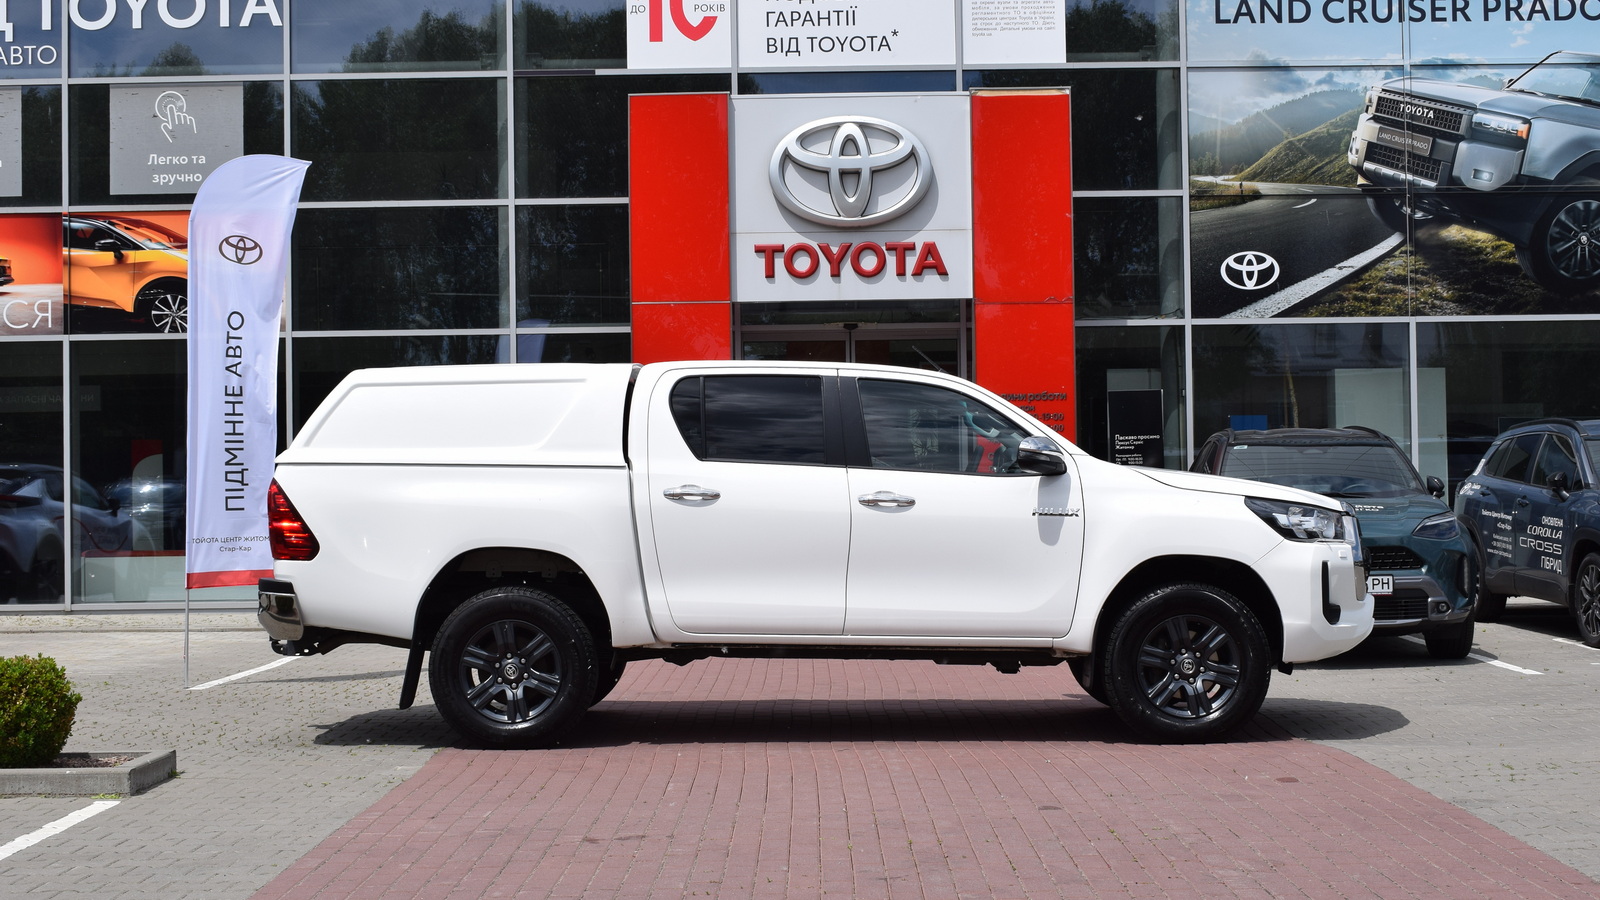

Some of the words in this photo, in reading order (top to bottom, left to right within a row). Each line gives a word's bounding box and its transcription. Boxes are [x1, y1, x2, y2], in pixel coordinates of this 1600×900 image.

[630, 5, 646, 15] ДО
[694, 4, 726, 13] РОКІВ
[1214, 0, 1313, 25] LAND
[1321, 0, 1472, 24] CRUISER
[1482, 0, 1600, 23] PRADO
[766, 6, 859, 28] ГАРАНТІЇ
[766, 37, 801, 56] ВІД
[1400, 103, 1434, 119] TOYOTA
[1378, 132, 1392, 140] LAND
[147, 154, 189, 165] Легко
[191, 155, 206, 165] та
[152, 173, 203, 184] зручно
[754, 241, 949, 279] TOYOTA
[225, 311, 245, 377] АВТО
[1028, 391, 1067, 402] роботи
[224, 385, 249, 512] ПІДМІННЕ
[1032, 506, 1080, 517] HILUX
[1526, 524, 1563, 540] COROLLA
[1519, 536, 1562, 555] CROSS
